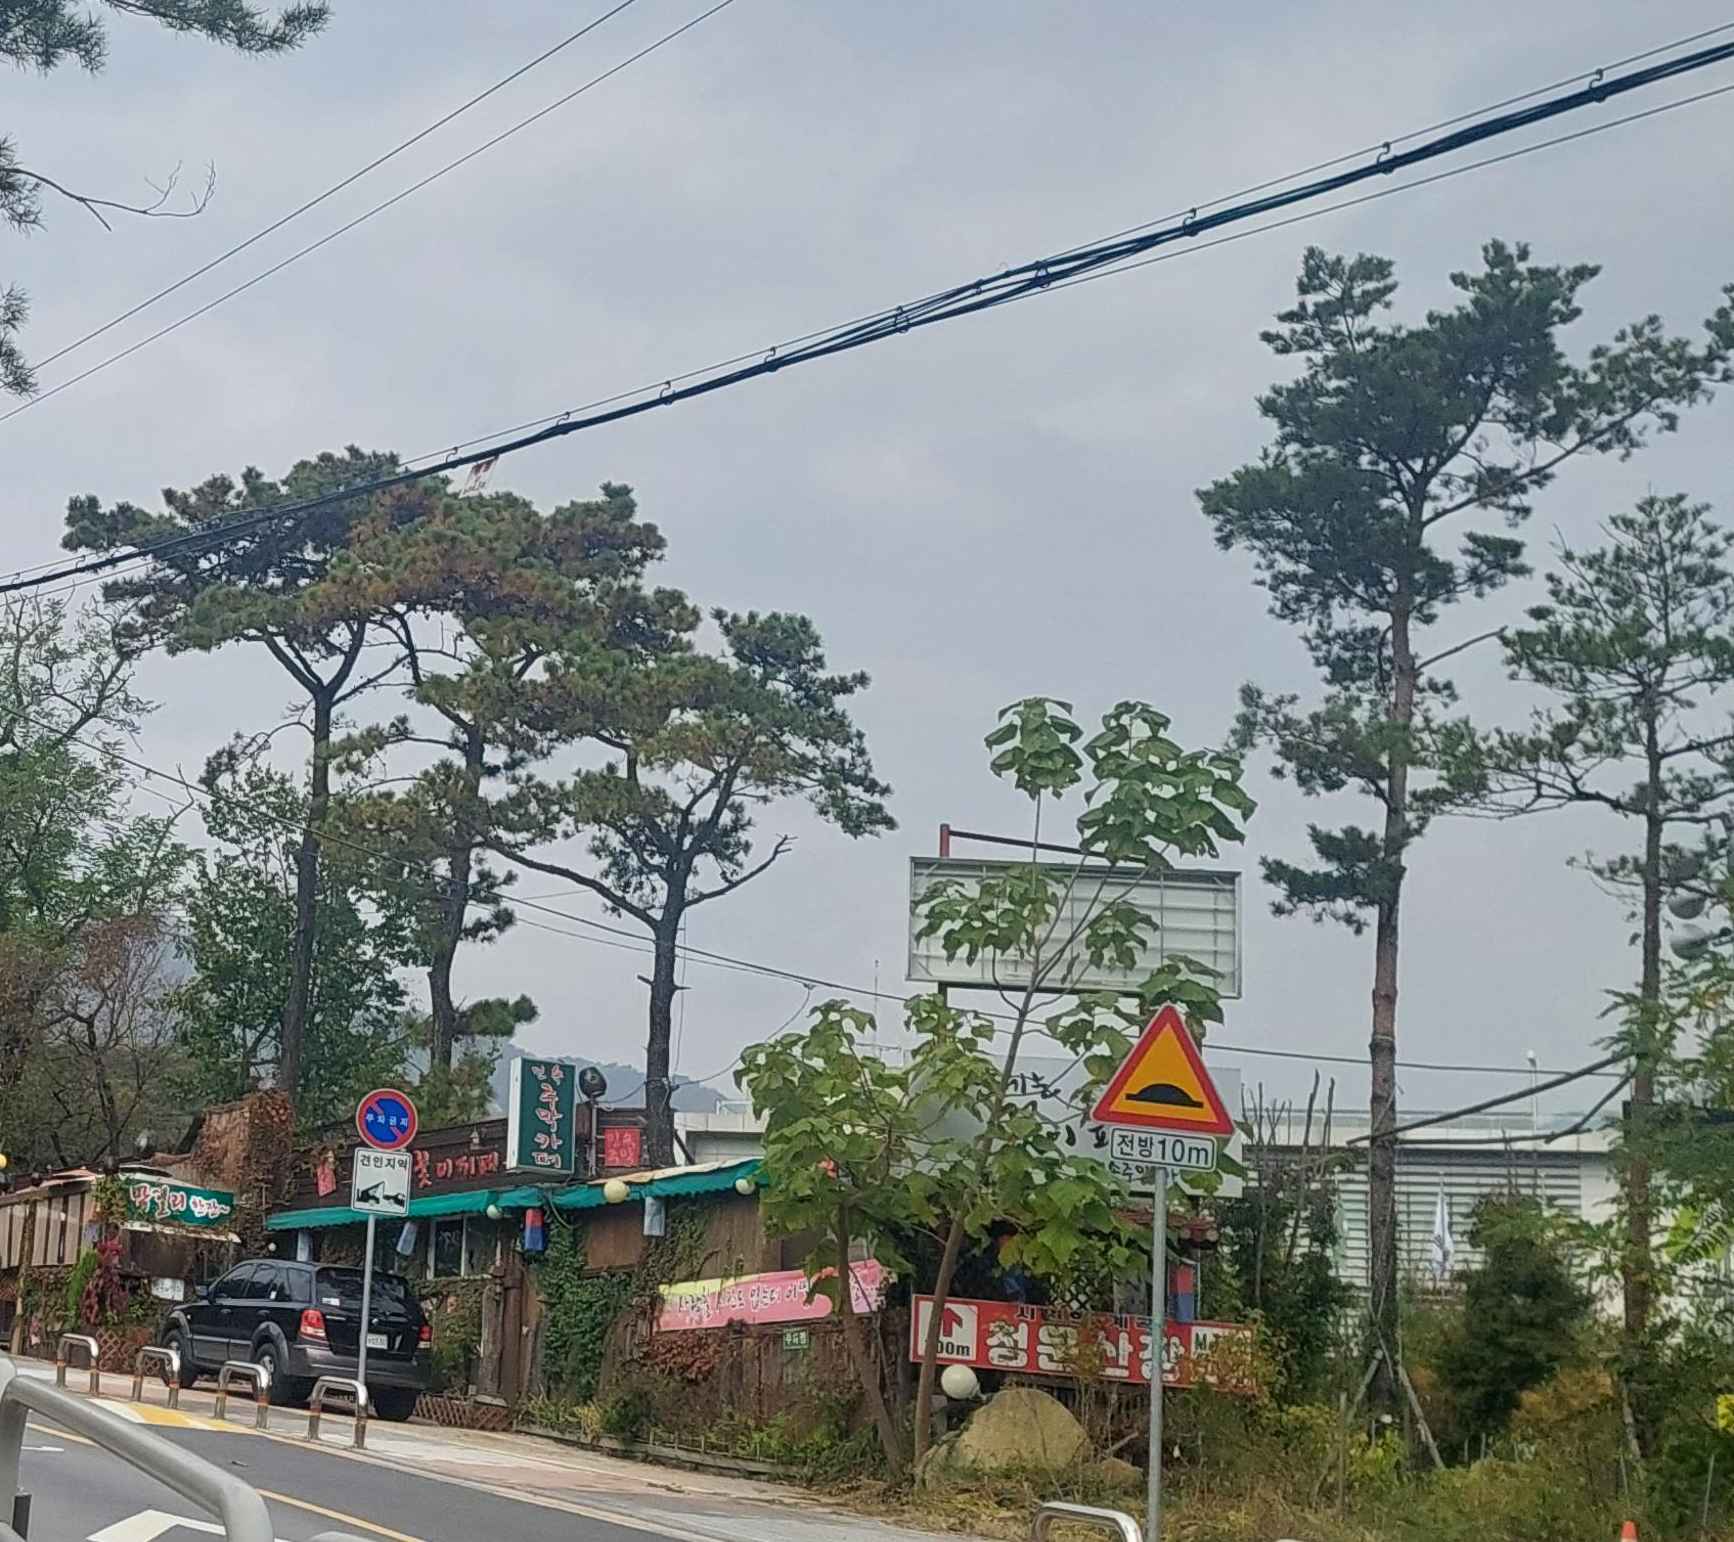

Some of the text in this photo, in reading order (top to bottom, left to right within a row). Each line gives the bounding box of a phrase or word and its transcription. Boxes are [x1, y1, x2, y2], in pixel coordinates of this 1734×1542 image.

[366, 1113, 408, 1128] 주차금지
[1116, 1136, 1210, 1167] 전방10m
[361, 1154, 408, 1171] 견인지역
[130, 1183, 186, 1219] 막걸리
[926, 1339, 971, 1357] 00m
